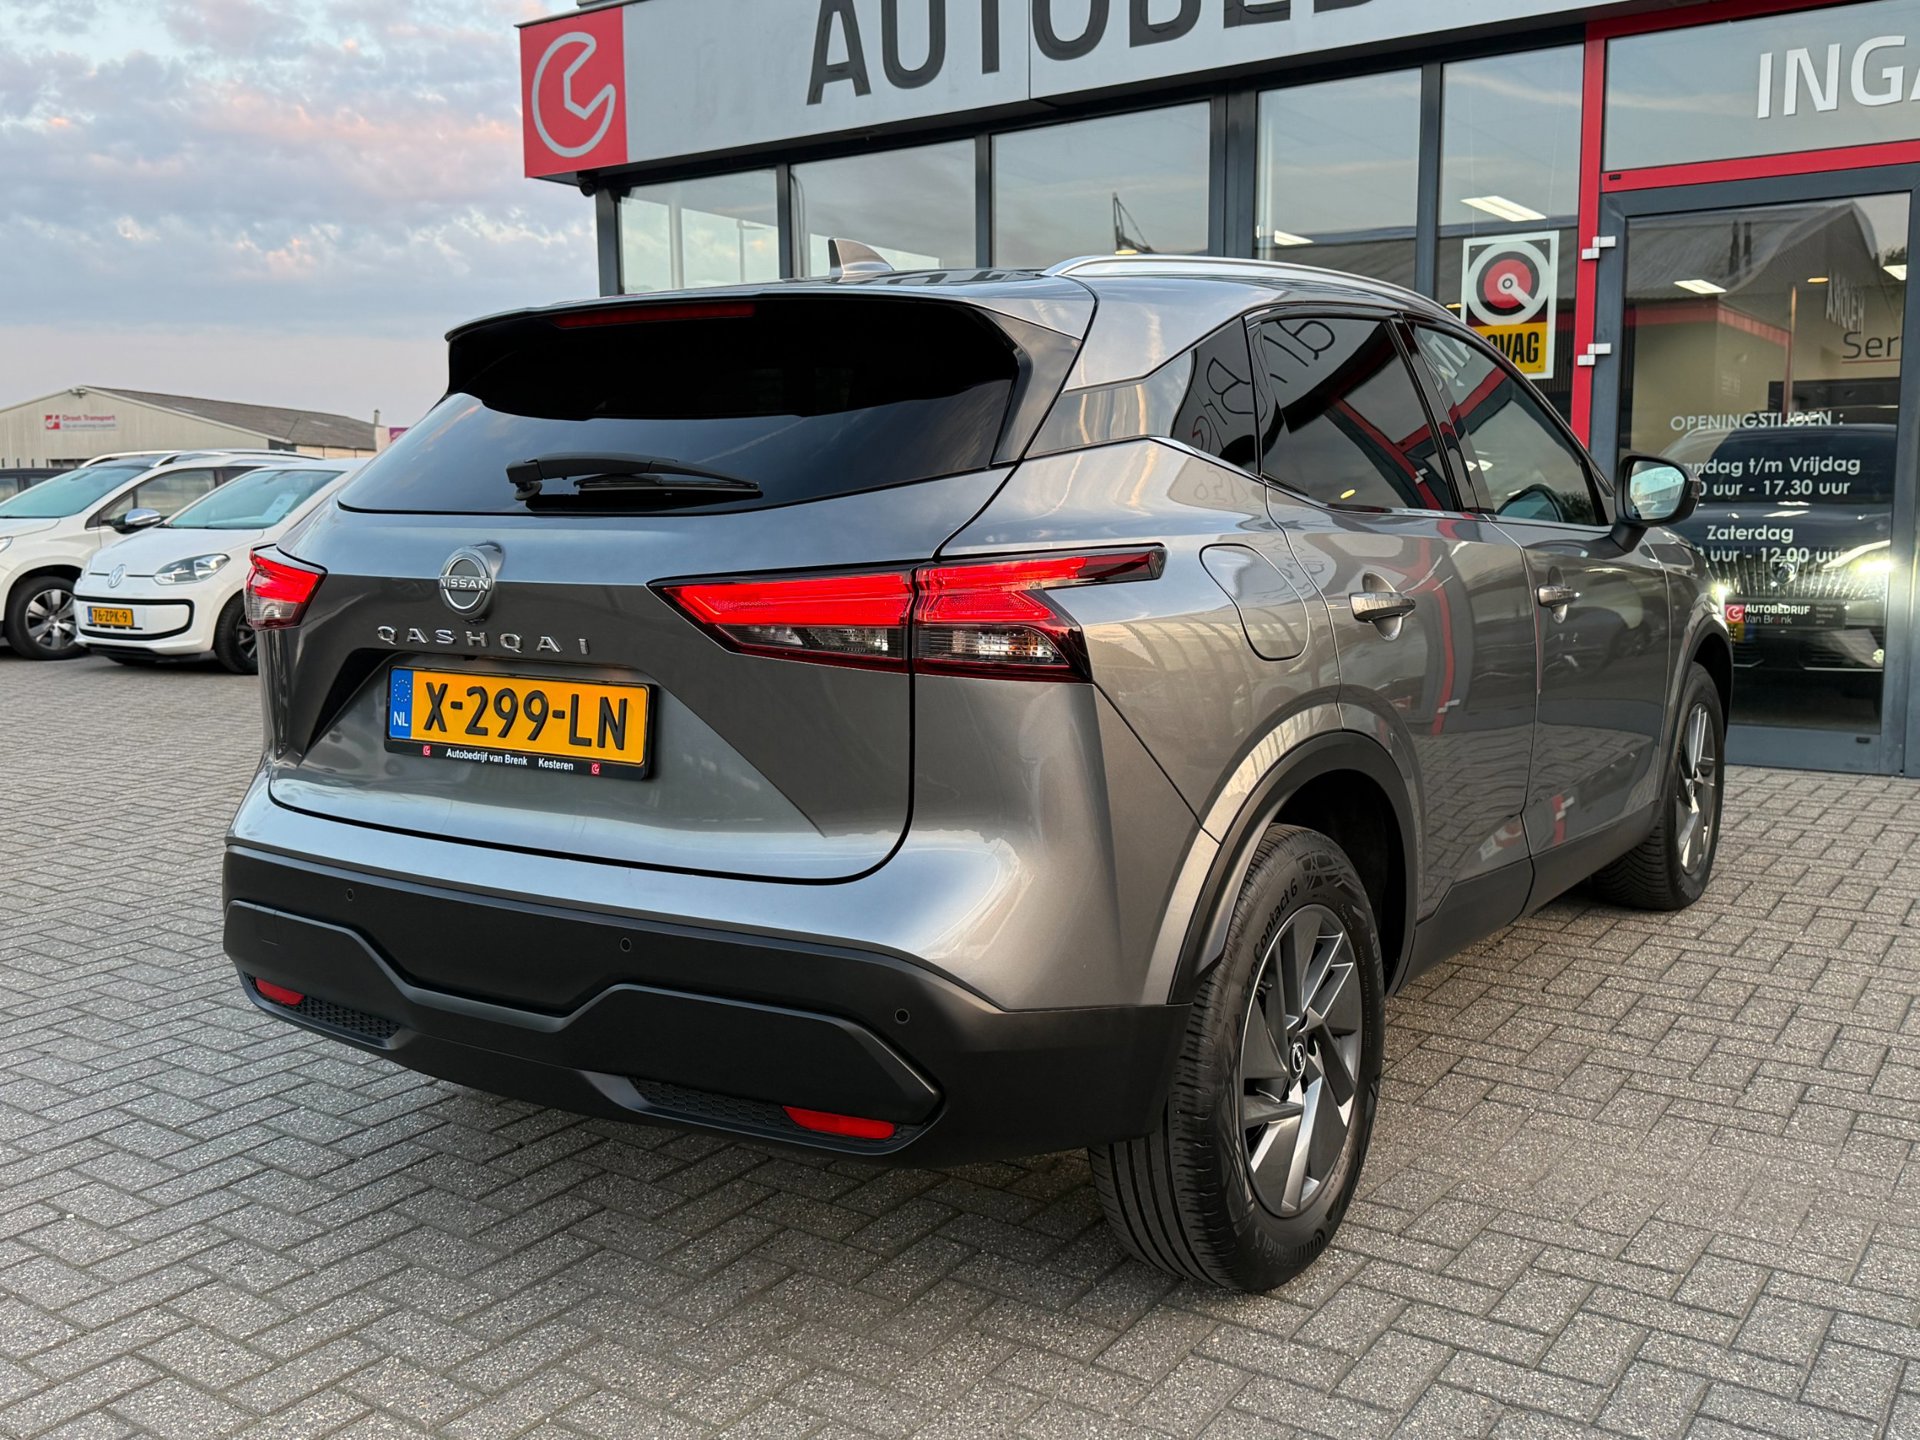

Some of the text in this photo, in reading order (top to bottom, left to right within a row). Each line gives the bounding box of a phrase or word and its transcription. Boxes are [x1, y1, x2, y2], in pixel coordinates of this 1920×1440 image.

[806, 0, 1372, 105] AUTO
[1757, 35, 1920, 119] ING
[1486, 332, 1539, 364] VAG
[1670, 411, 1832, 431] OPENINGSTIJDEN
[1749, 458, 1783, 475] t/m
[1790, 456, 1861, 475] Vrijdag
[1713, 484, 1743, 496] uur
[1763, 480, 1813, 495] 17.30
[1819, 482, 1851, 495] uur
[1707, 525, 1794, 544] Zaterdag
[1710, 551, 1739, 563] uur
[1816, 551, 1846, 563] uu
[439, 578, 490, 590] NISSAN
[92, 609, 128, 623] 76-ZPK-9
[1745, 604, 1811, 616] AUTOBEDRIJF
[1745, 615, 1761, 624] Van
[377, 625, 590, 655] QASHQAI
[393, 711, 409, 727] NL
[423, 682, 628, 751] X-299-LN
[446, 748, 574, 771] Autobedrijf van Brenk Kesteren
[1290, 878, 1298, 897] 6
